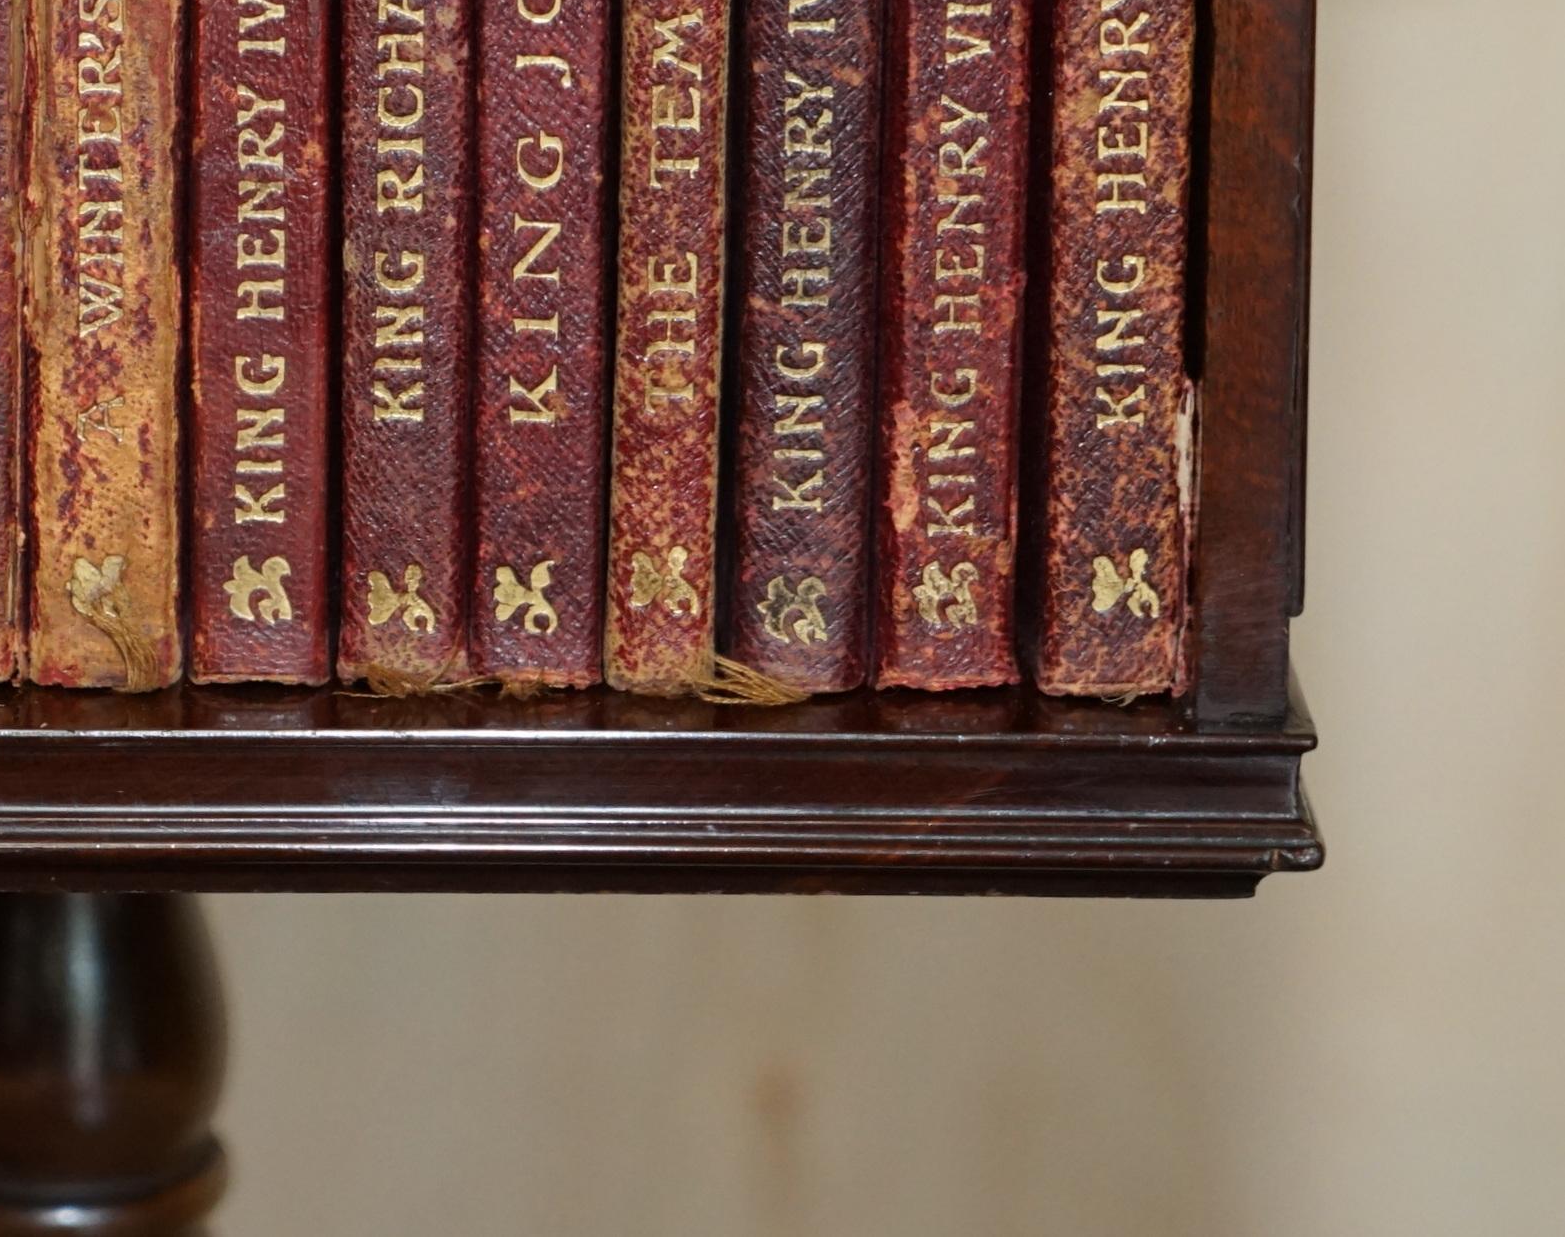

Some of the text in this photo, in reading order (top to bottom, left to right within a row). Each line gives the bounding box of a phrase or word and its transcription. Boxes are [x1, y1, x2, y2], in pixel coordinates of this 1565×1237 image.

[236, 83, 287, 321] HENRY
[779, 69, 834, 308] HENRY
[933, 93, 989, 336] HENRY
[372, 249, 426, 422] KING
[508, 128, 564, 424] KING
[644, 249, 699, 414] THE
[1094, 253, 1146, 430] KING
[76, 395, 125, 443] A
[234, 353, 286, 524] KING
[771, 341, 827, 513] KING
[925, 366, 979, 539] KING
